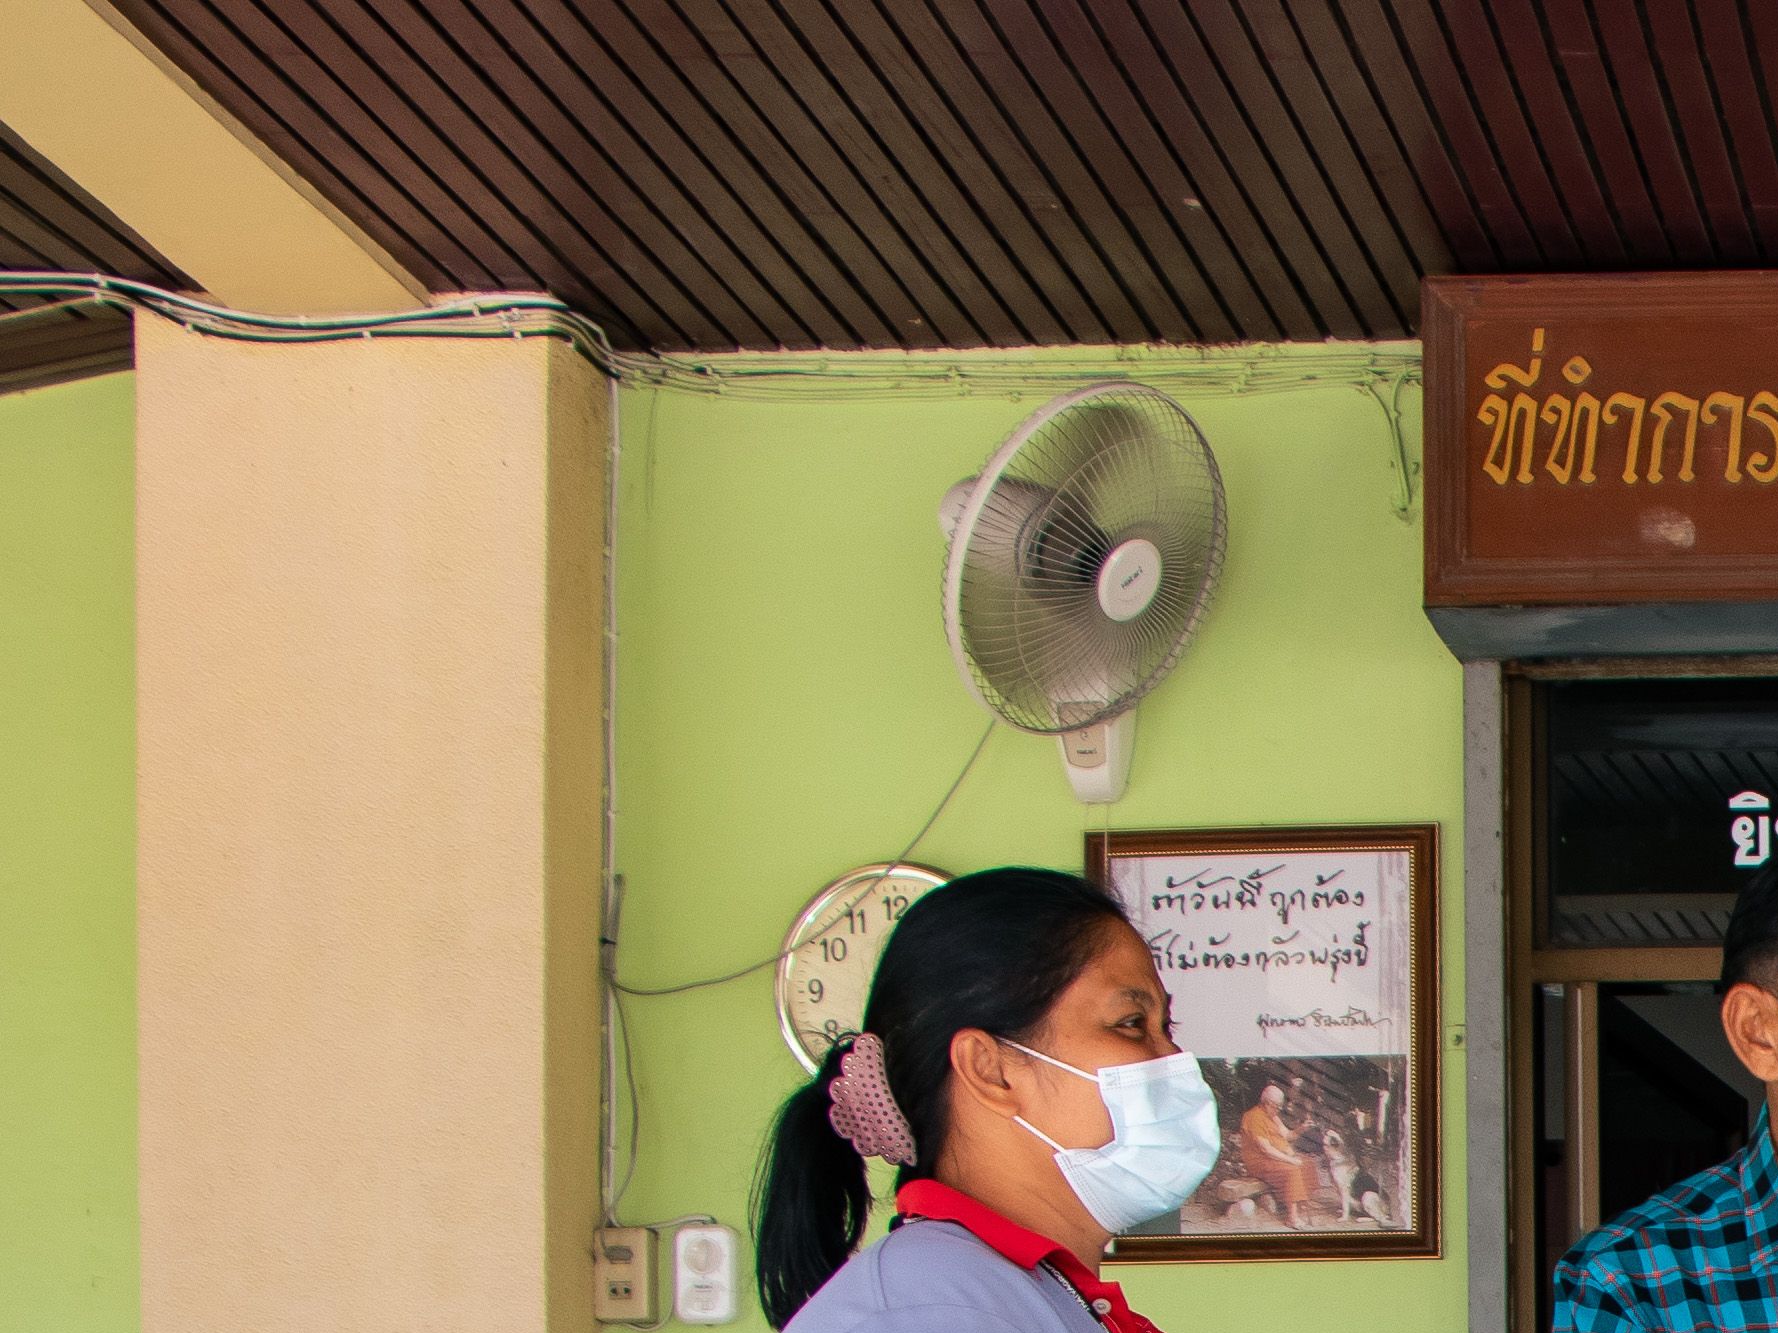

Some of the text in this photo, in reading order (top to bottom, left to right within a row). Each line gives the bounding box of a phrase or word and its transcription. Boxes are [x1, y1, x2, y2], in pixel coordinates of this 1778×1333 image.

[845, 909, 865, 934] 11
[820, 937, 846, 961] 10
[809, 979, 823, 1003] 9
